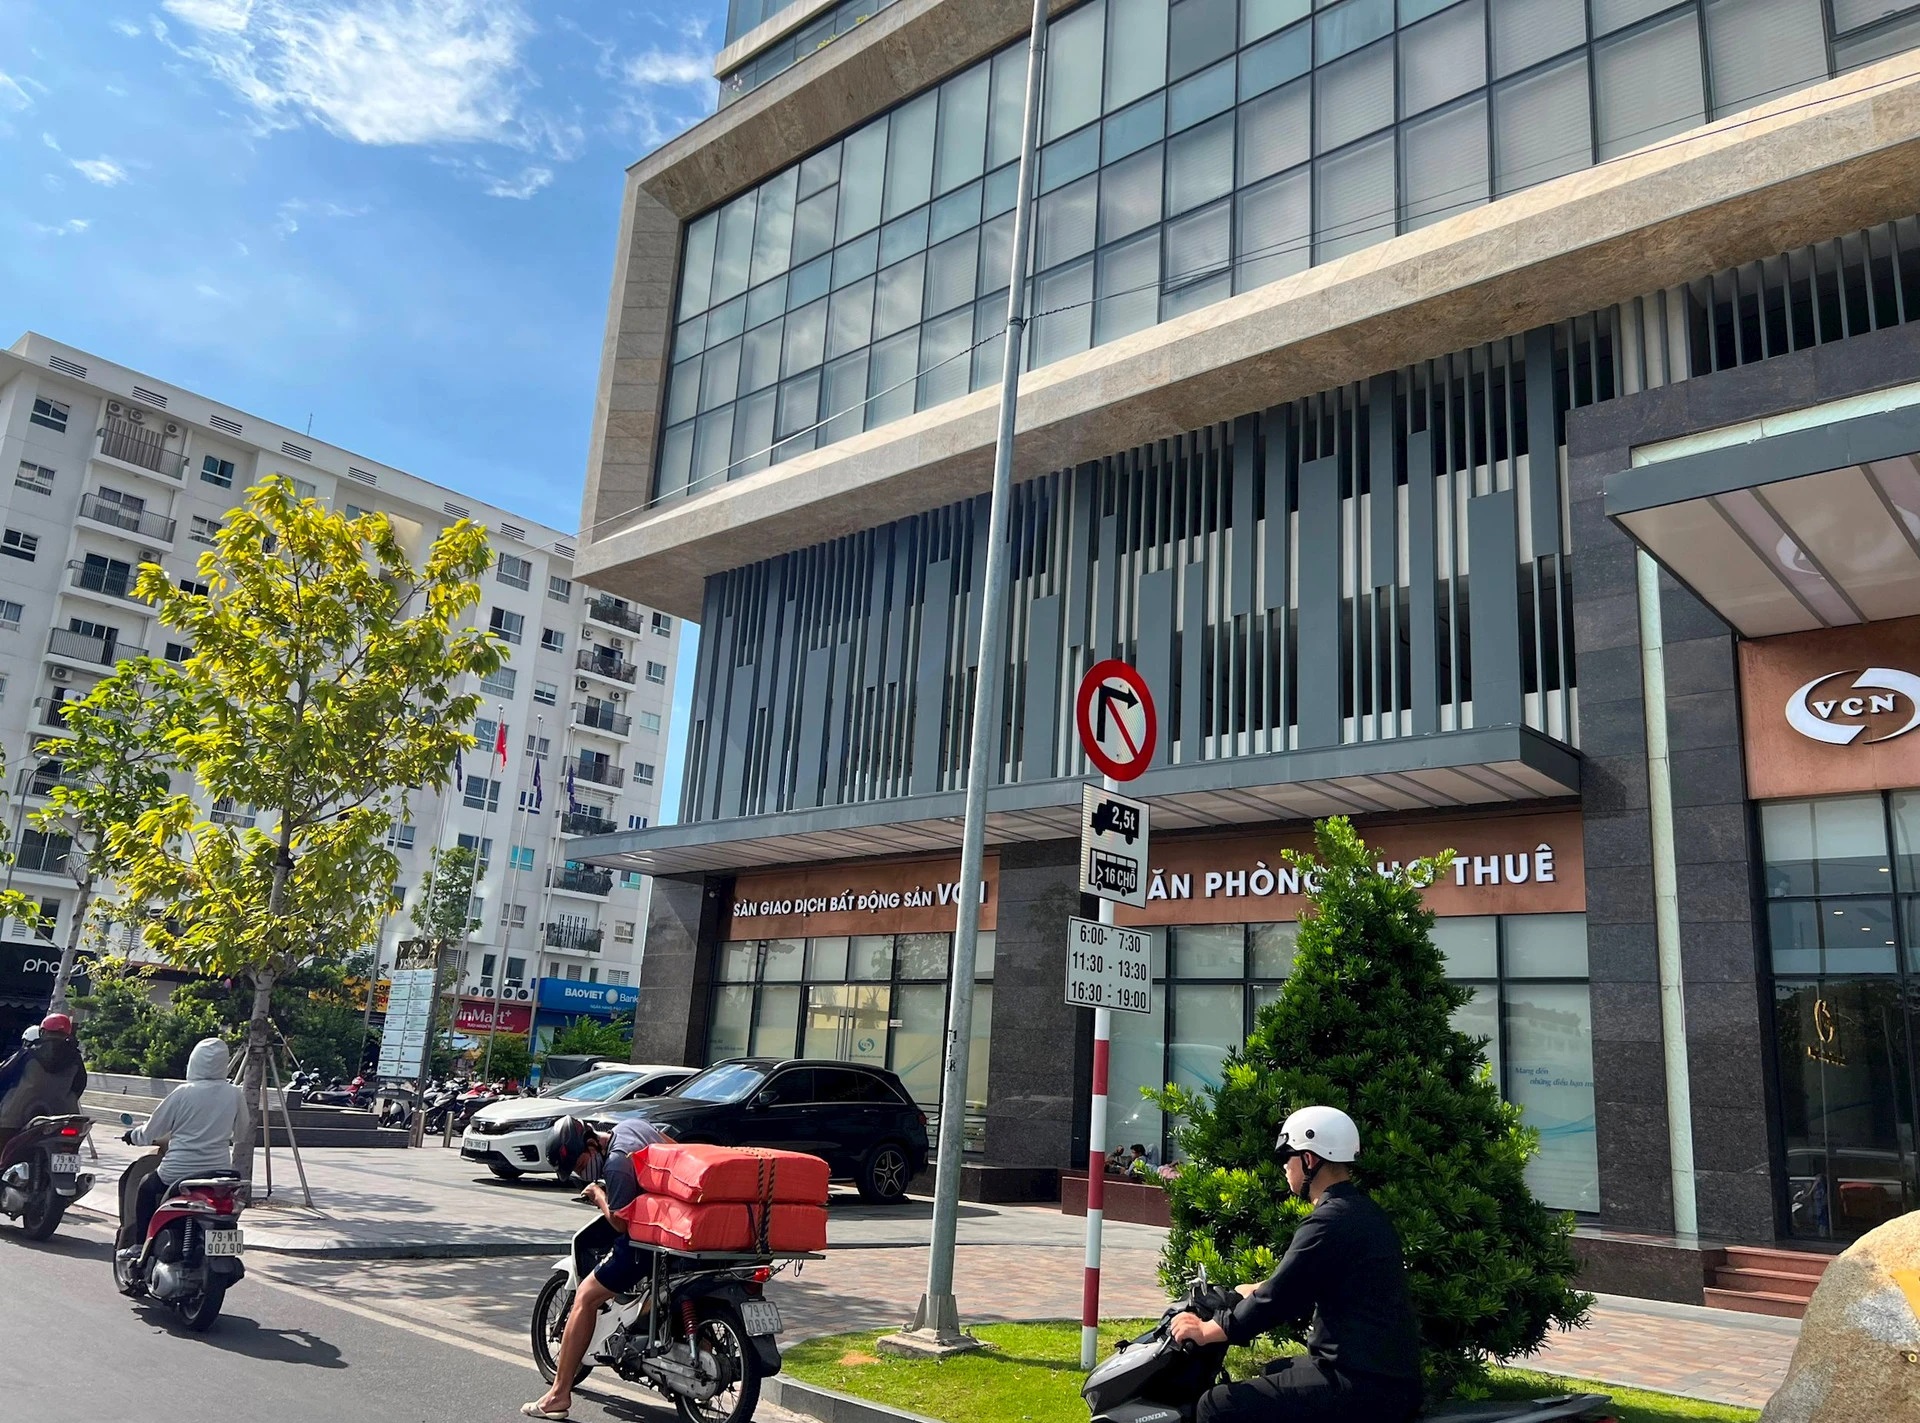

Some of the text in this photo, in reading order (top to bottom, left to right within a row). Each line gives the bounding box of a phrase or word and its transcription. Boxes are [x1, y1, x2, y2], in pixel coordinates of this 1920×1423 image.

[1812, 694, 1895, 719] VCN
[1112, 805, 1135, 830] 2,5t
[1451, 843, 1555, 885] THUÊ
[733, 899, 757, 917] SÀN
[760, 900, 791, 915] GIAO
[795, 897, 826, 917] DỊCH
[830, 889, 855, 911] BẤT
[858, 890, 900, 913] ĐỘNG
[904, 886, 932, 907] SẢN
[1119, 933, 1141, 953] 7:30
[1072, 951, 1103, 973] 11:30
[1118, 960, 1147, 981] 13:30
[564, 987, 604, 1000] BAOVIET
[1072, 981, 1102, 1002] 16:30
[1117, 988, 1147, 1009] 19:00
[1134, 1411, 1168, 1423] HONDA
